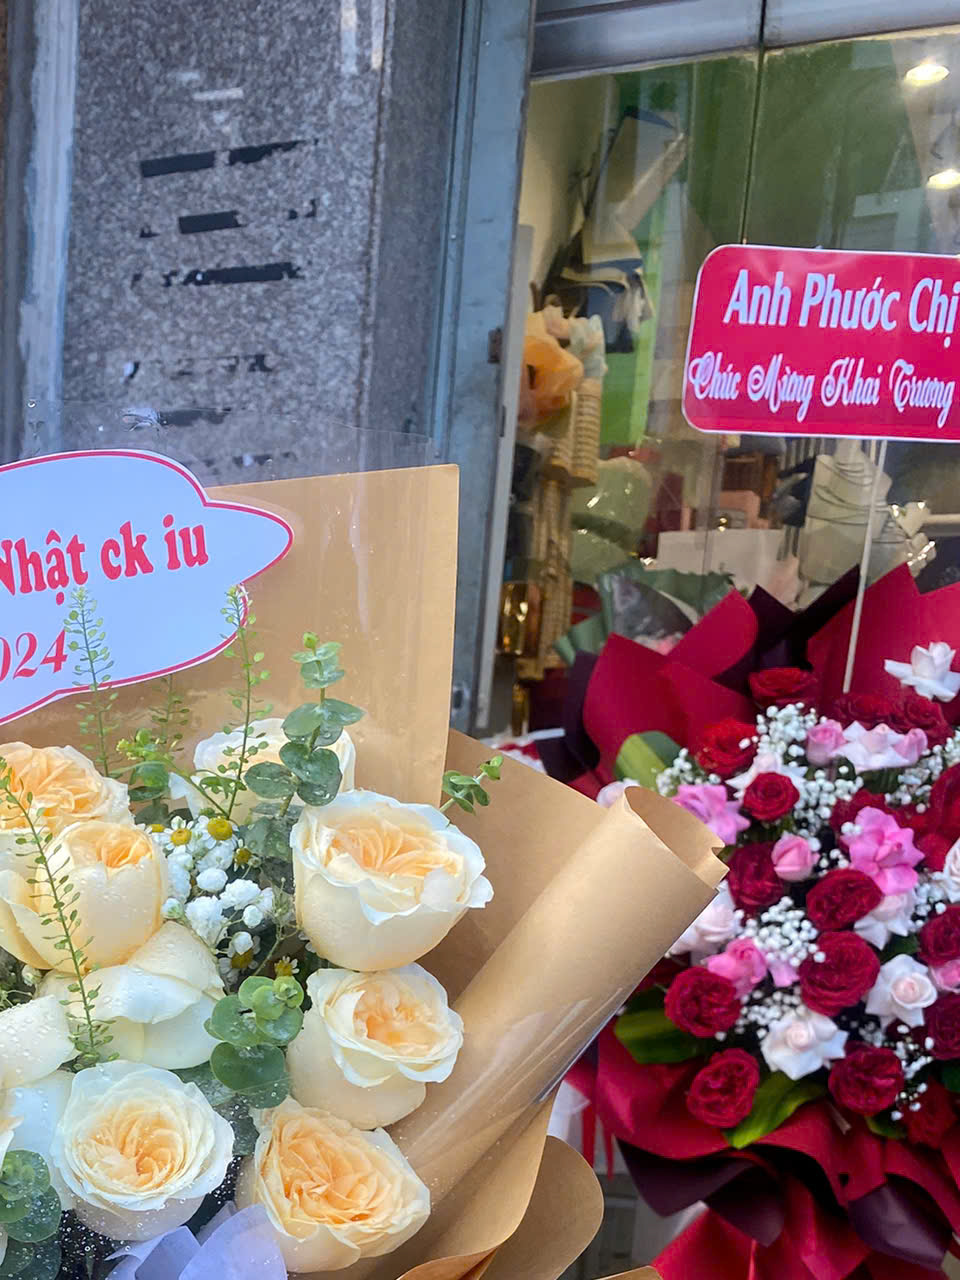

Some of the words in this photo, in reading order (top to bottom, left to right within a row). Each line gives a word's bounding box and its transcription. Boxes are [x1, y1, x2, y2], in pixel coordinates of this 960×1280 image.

[722, 269, 792, 327] Anh
[798, 273, 900, 331] Phước
[908, 277, 960, 349] Chị
[689, 351, 742, 400] Chúc
[747, 353, 816, 423] Mừng
[821, 357, 884, 407] Khai
[889, 358, 956, 429] Trương
[100, 520, 155, 581] ck
[162, 514, 210, 571] iu
